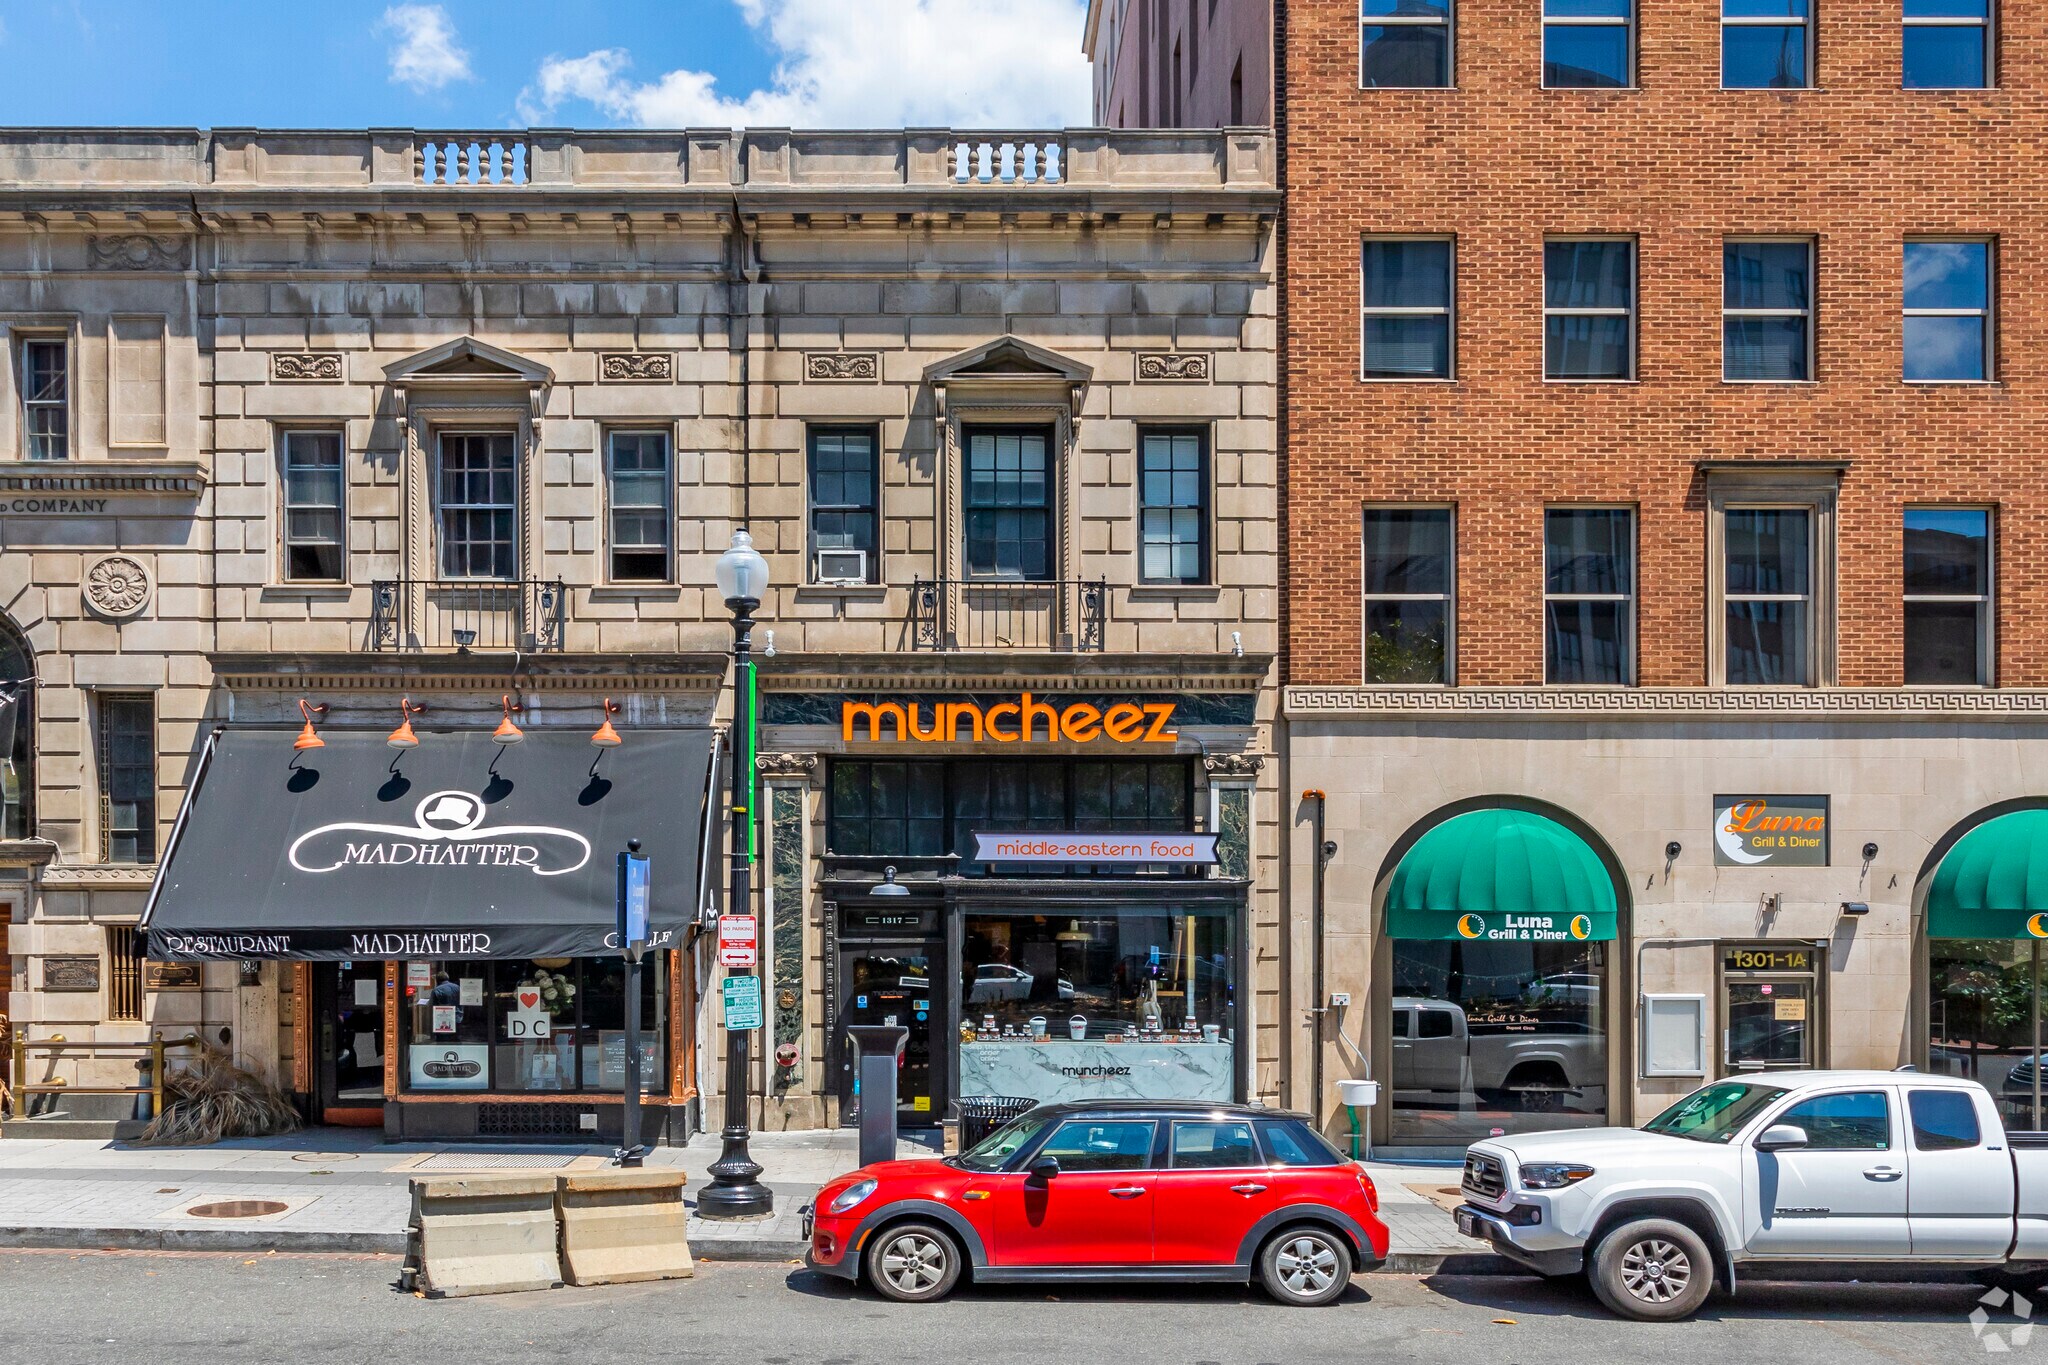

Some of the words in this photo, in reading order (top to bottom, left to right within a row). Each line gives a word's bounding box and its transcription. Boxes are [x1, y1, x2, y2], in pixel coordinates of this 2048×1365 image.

[12, 499, 107, 512] COMPANY
[842, 691, 1179, 743] muncheez
[1723, 799, 1825, 833] Luna
[997, 839, 1143, 856] middle-eastern
[1151, 841, 1194, 857] food
[1751, 836, 1775, 847] Grill
[1778, 836, 1787, 847] &
[1790, 836, 1821, 847] Diner
[341, 842, 539, 867] MADHATTER
[1505, 914, 1553, 928] Luna
[1488, 929, 1516, 940] Grill
[1520, 930, 1530, 940] &
[1533, 929, 1568, 940] Diner
[165, 935, 290, 954] RESTAURANT
[351, 932, 491, 954] MADHATTER
[1734, 952, 1806, 967] 1301-1A
[1467, 1014, 1484, 1022] Luna
[1488, 1014, 1506, 1023] Grill
[1509, 1014, 1516, 1022] &
[1519, 1014, 1540, 1023] Diner
[1062, 1065, 1131, 1076] muncheez
